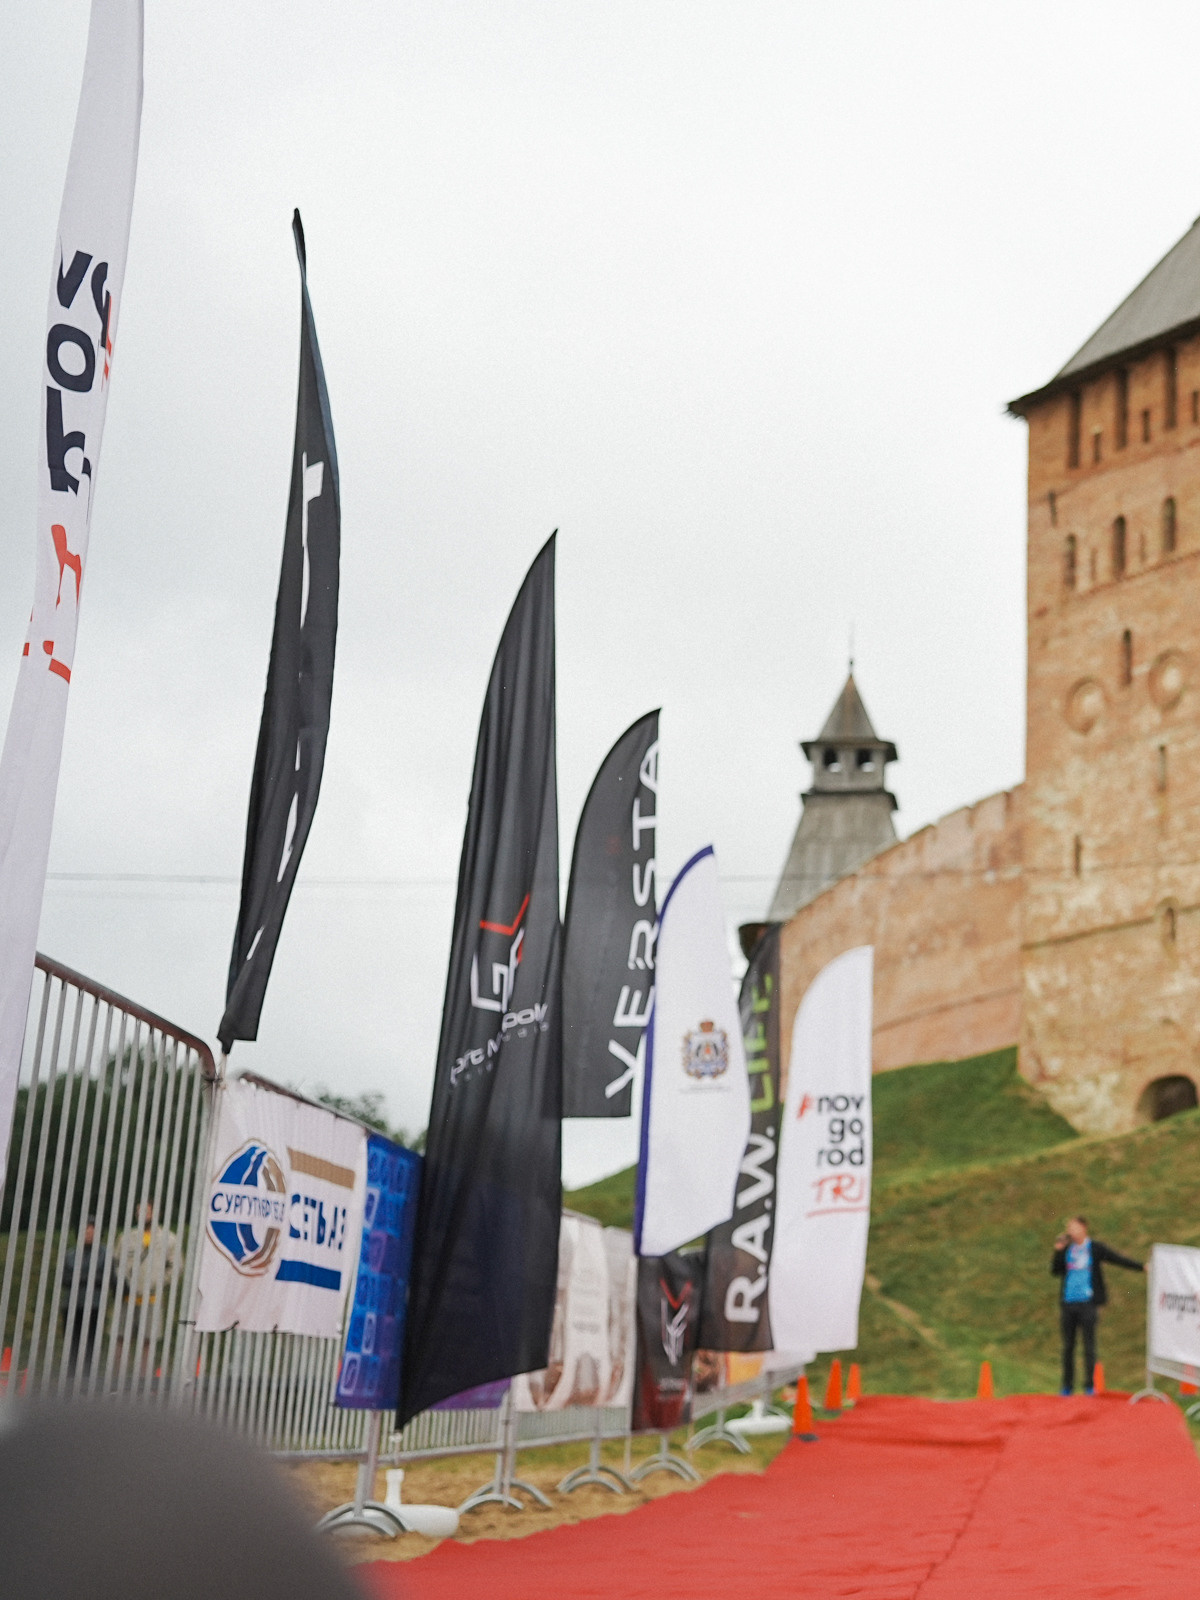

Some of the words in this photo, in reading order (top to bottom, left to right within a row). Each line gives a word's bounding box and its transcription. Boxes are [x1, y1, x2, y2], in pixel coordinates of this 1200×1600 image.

[829, 1117, 864, 1144] go
[816, 1139, 865, 1167] rod
[812, 1173, 866, 1203] TRI
